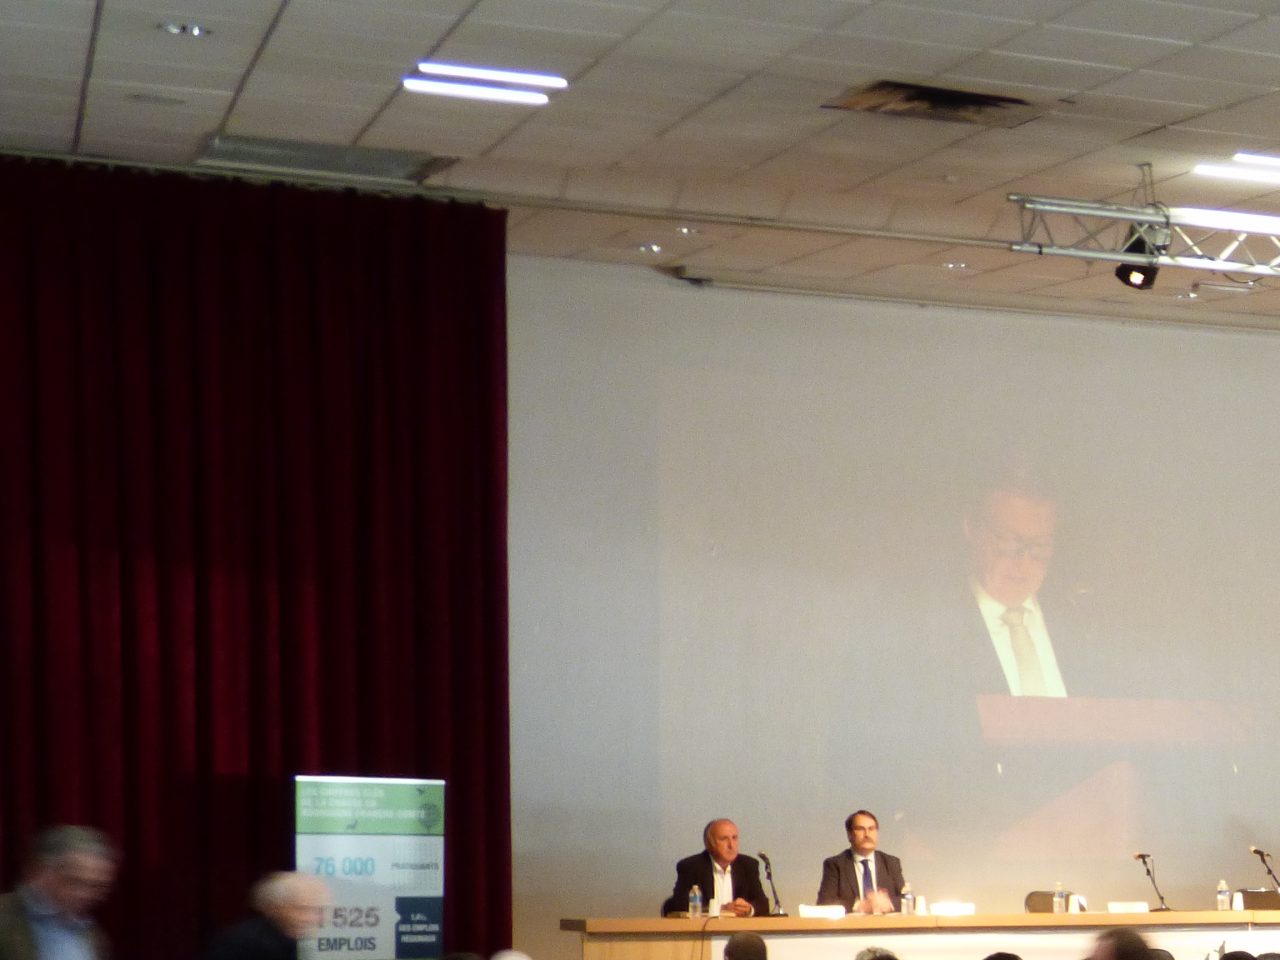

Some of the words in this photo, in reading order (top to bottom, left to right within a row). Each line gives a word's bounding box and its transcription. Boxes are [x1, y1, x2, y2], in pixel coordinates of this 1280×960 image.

[313, 857, 336, 876] 76
[342, 857, 376, 877] 000
[333, 907, 380, 928] 525
[317, 936, 377, 951] EMPLOIS
